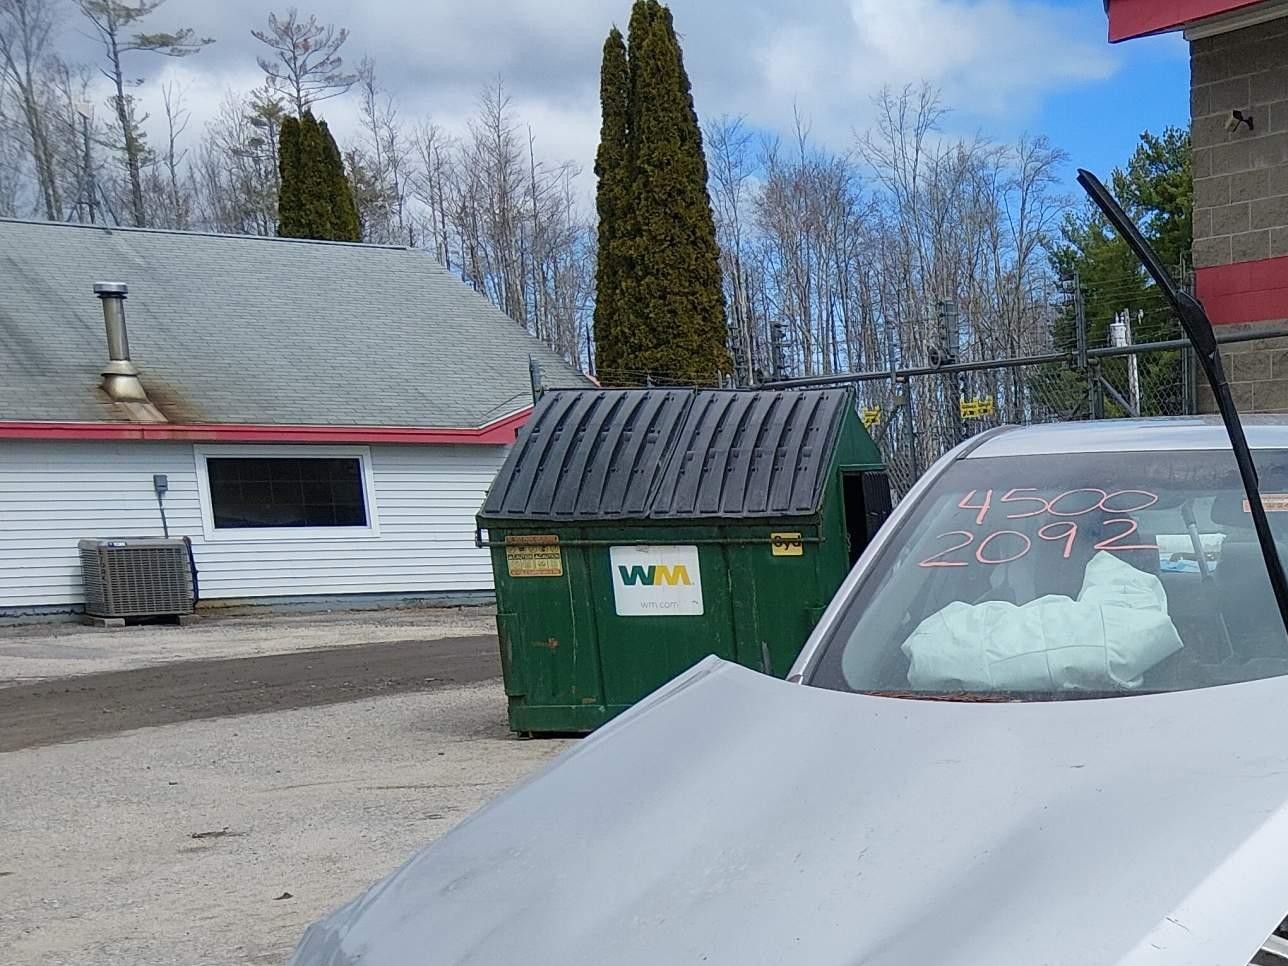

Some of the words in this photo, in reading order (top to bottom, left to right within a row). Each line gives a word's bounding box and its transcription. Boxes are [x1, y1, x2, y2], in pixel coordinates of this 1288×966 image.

[958, 488, 1159, 525] 4500
[918, 519, 1161, 567] 2092
[618, 565, 692, 586] WM
